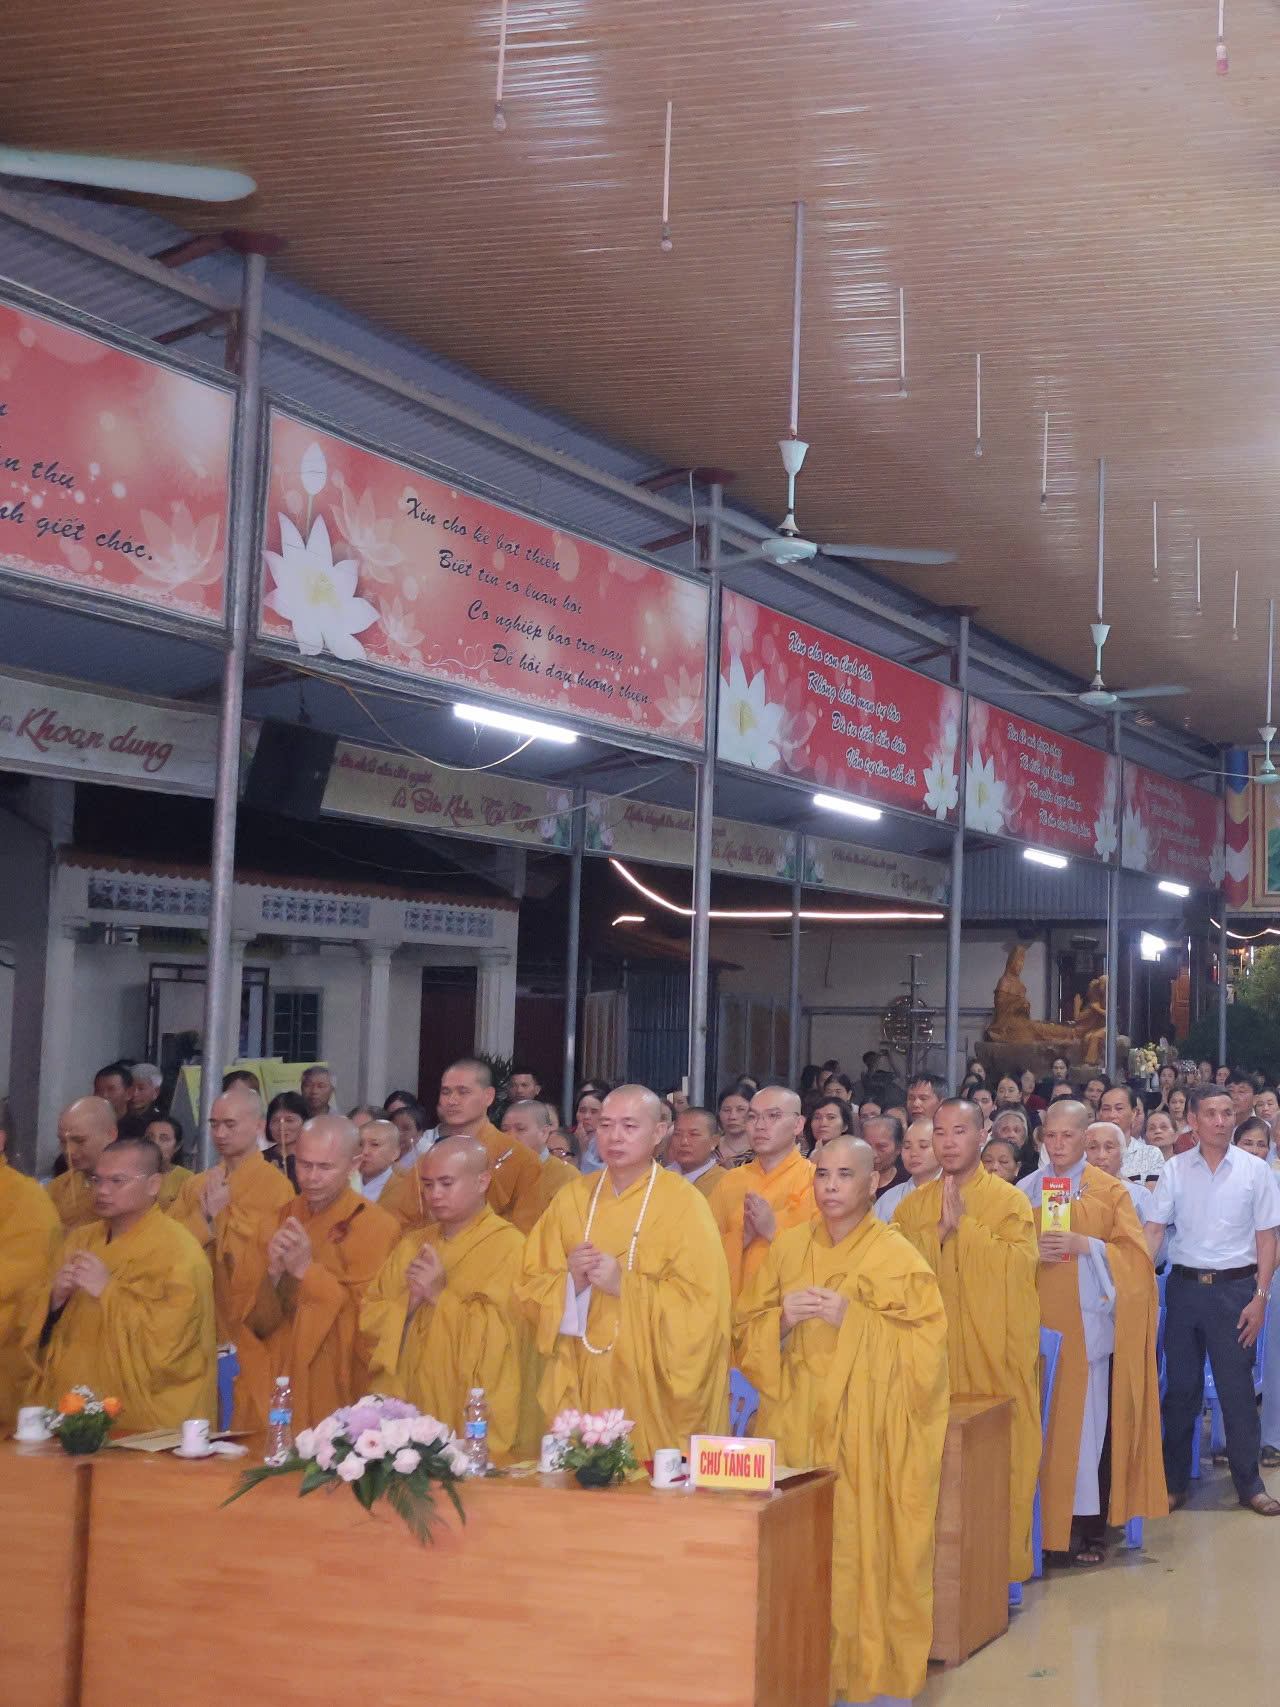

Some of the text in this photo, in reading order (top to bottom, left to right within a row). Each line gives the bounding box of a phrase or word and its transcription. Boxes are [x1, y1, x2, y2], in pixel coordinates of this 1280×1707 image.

[407, 497, 436, 525] Xin
[443, 516, 468, 536] cho
[36, 517, 86, 541] giết
[96, 529, 153, 560] chóc.
[439, 549, 473, 576] Biết
[478, 568, 499, 587] tin
[495, 614, 543, 641] nghiệp
[519, 653, 542, 674] hồi
[789, 631, 806, 655] Xin
[808, 642, 823, 662] cho
[824, 652, 839, 668] con
[808, 671, 837, 704] Không
[16, 707, 105, 753] Khoan
[108, 725, 174, 773] dung
[832, 711, 846, 734] Dù
[700, 1449, 765, 1479] CHƯ TĂNG NI
